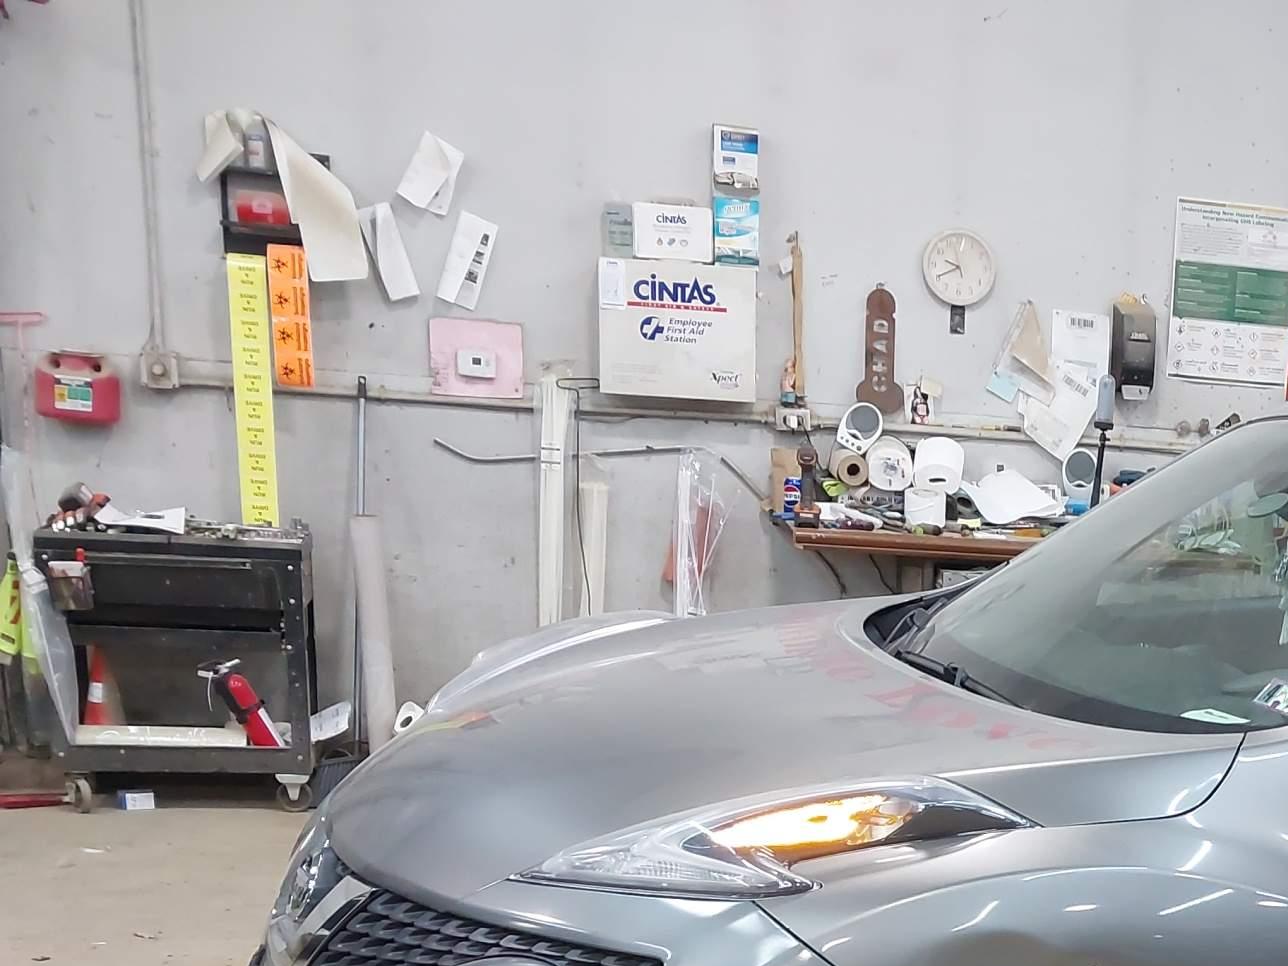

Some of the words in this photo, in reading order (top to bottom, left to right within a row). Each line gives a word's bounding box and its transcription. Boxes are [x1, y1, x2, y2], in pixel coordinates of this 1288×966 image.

[668, 317, 713, 327] Employee
[666, 326, 687, 334] First
[689, 327, 705, 336] Aid
[664, 335, 697, 344] Station
